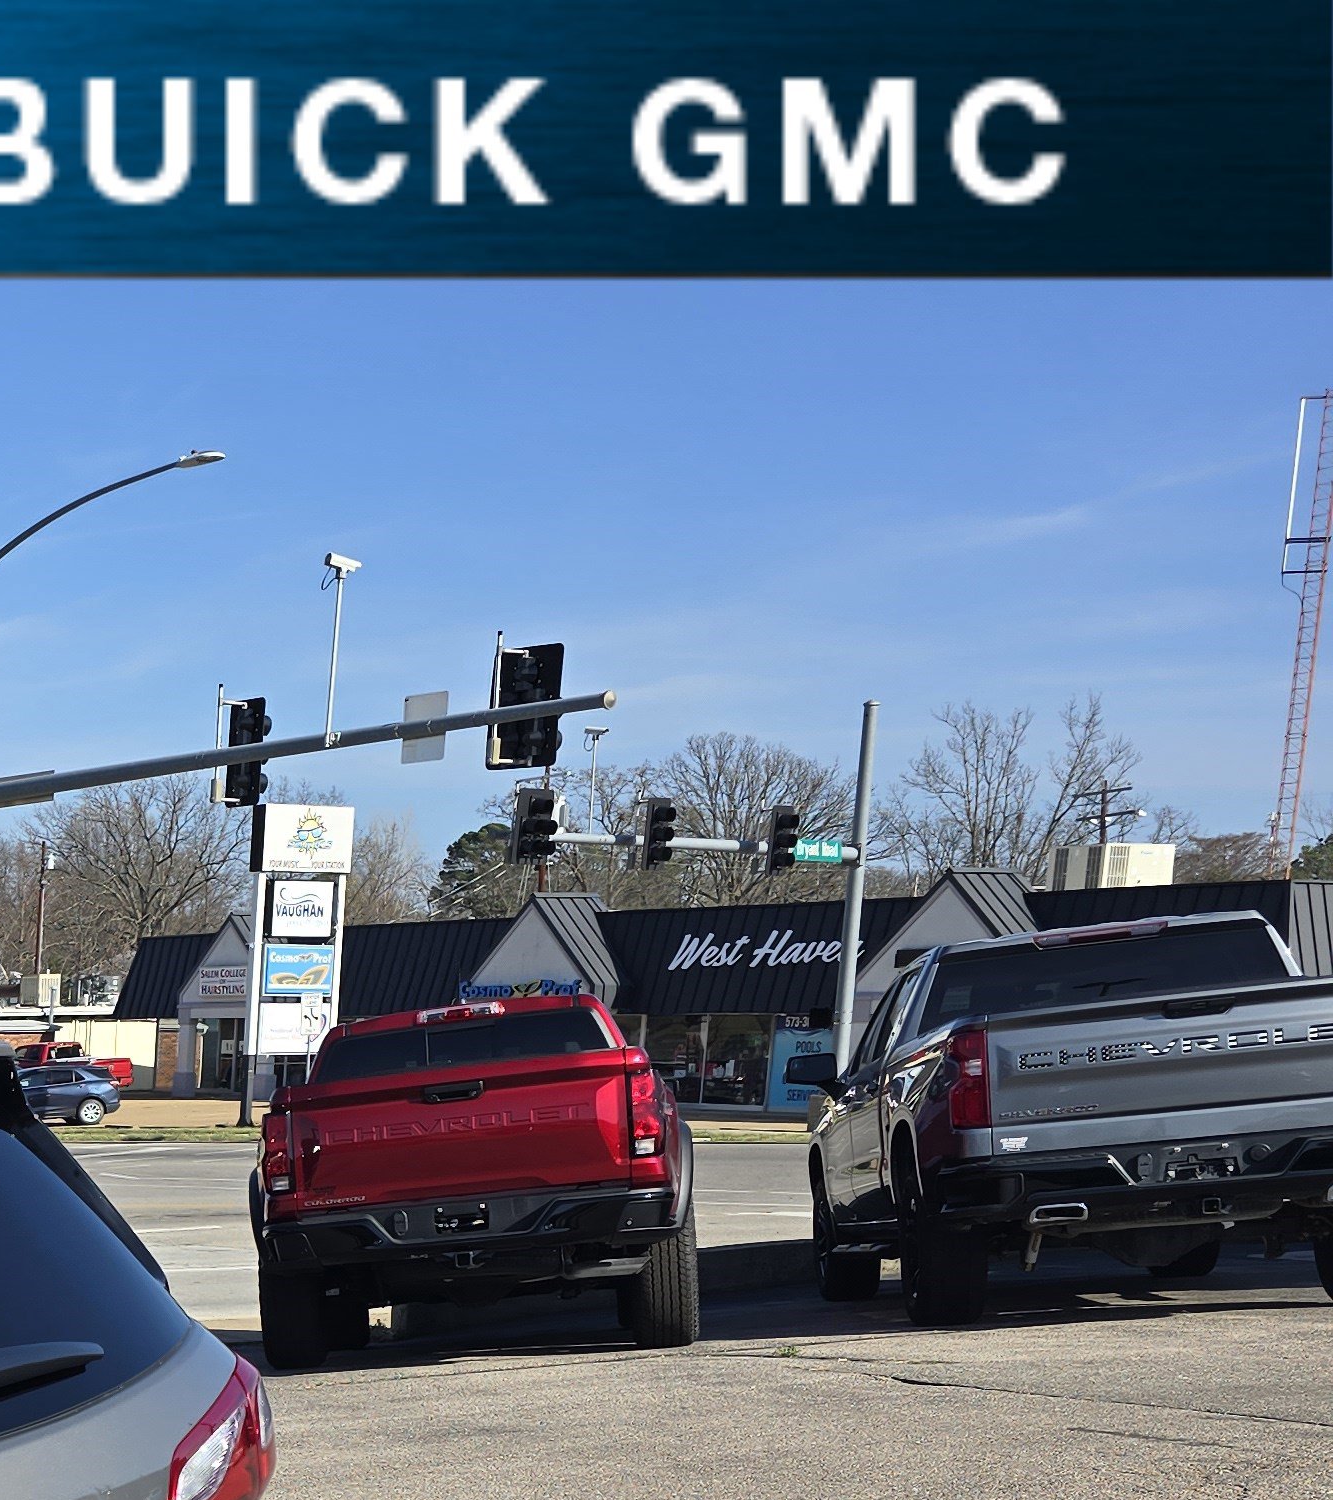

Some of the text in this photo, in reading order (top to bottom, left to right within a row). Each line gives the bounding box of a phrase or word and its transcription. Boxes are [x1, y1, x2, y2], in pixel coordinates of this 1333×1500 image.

[276, 903, 324, 918] VAUGHAN
[269, 951, 300, 963] Cosmo
[667, 929, 865, 971] West Have
[459, 979, 583, 998] Cosmo Prof
[795, 1041, 822, 1053] POOLS
[324, 1102, 591, 1146] CHEVROLET
